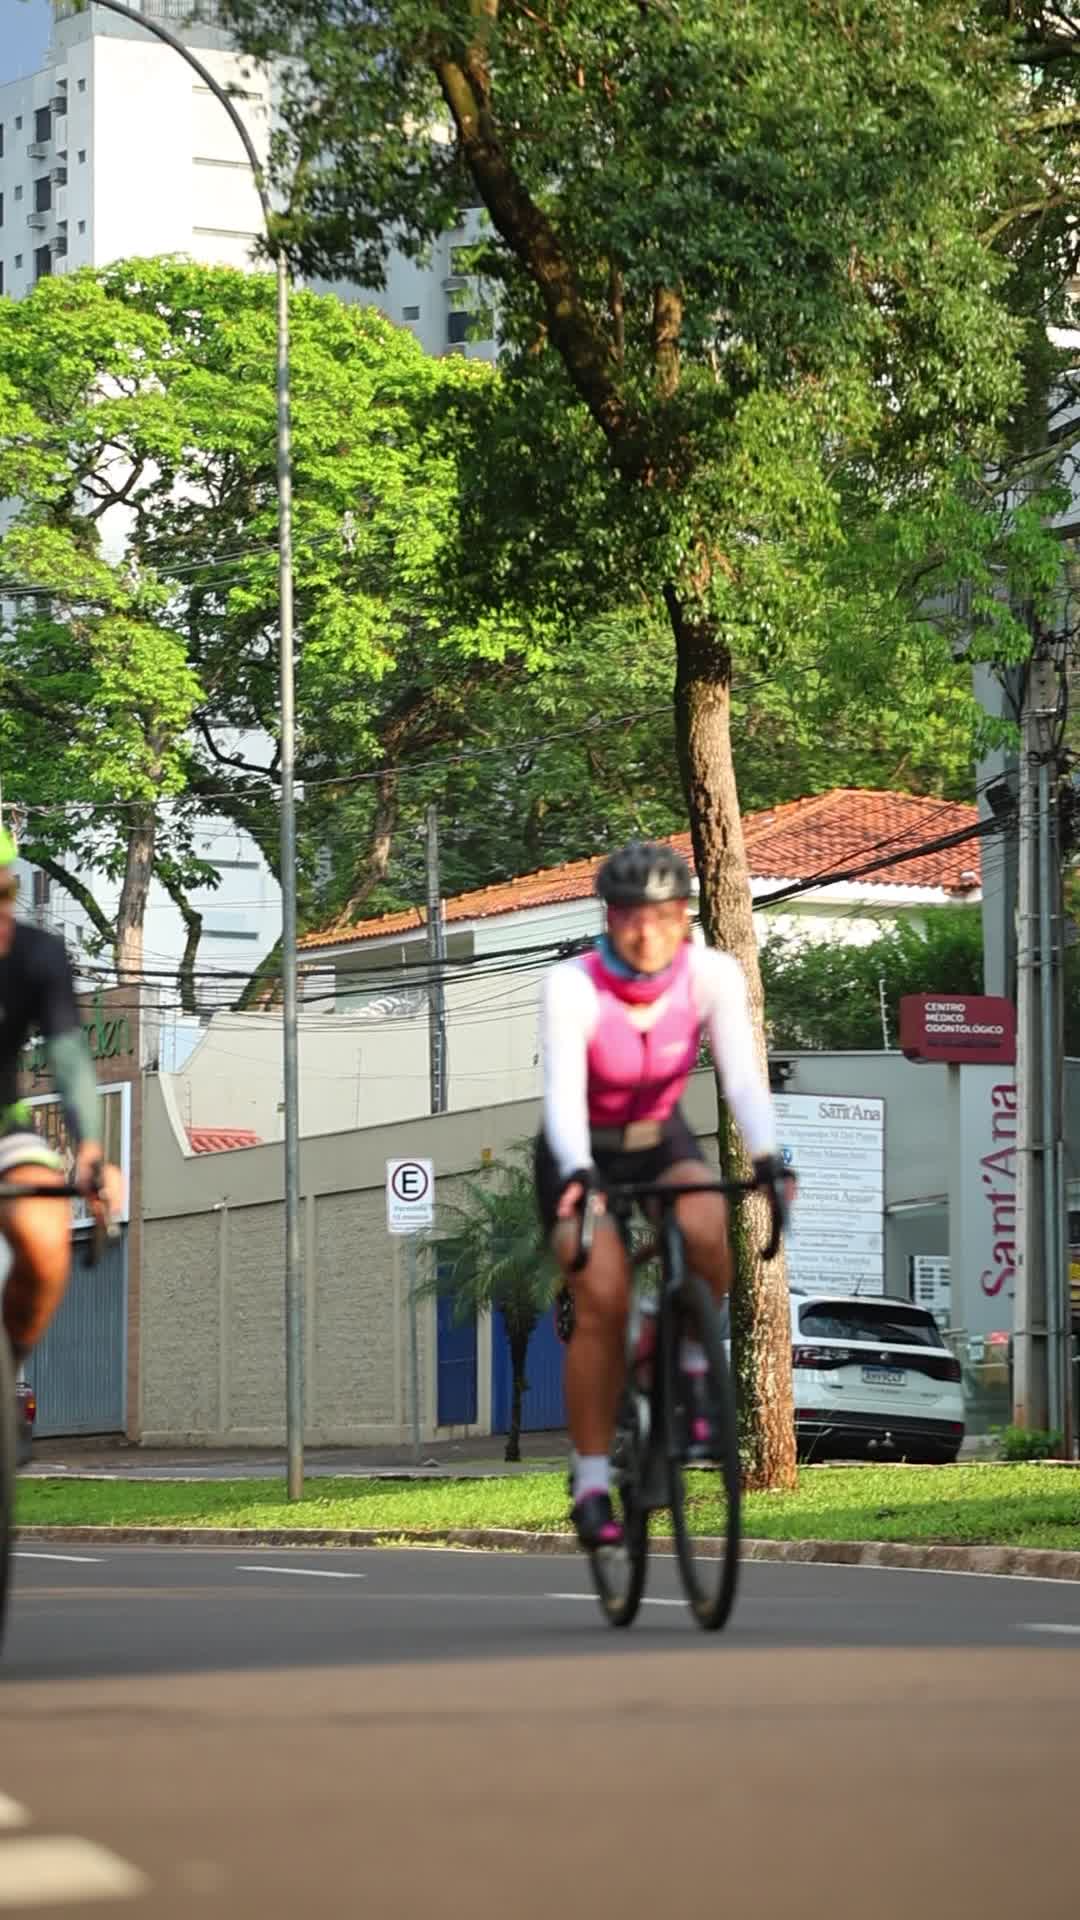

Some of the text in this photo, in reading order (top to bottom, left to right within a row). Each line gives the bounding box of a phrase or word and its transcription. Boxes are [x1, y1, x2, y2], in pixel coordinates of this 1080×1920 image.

[924, 1002, 966, 1012] CENTRO
[925, 1011, 965, 1022] MÉDICO
[924, 1023, 1004, 1034] ODONTOLÓGICO
[402, 1170, 419, 1194] E
